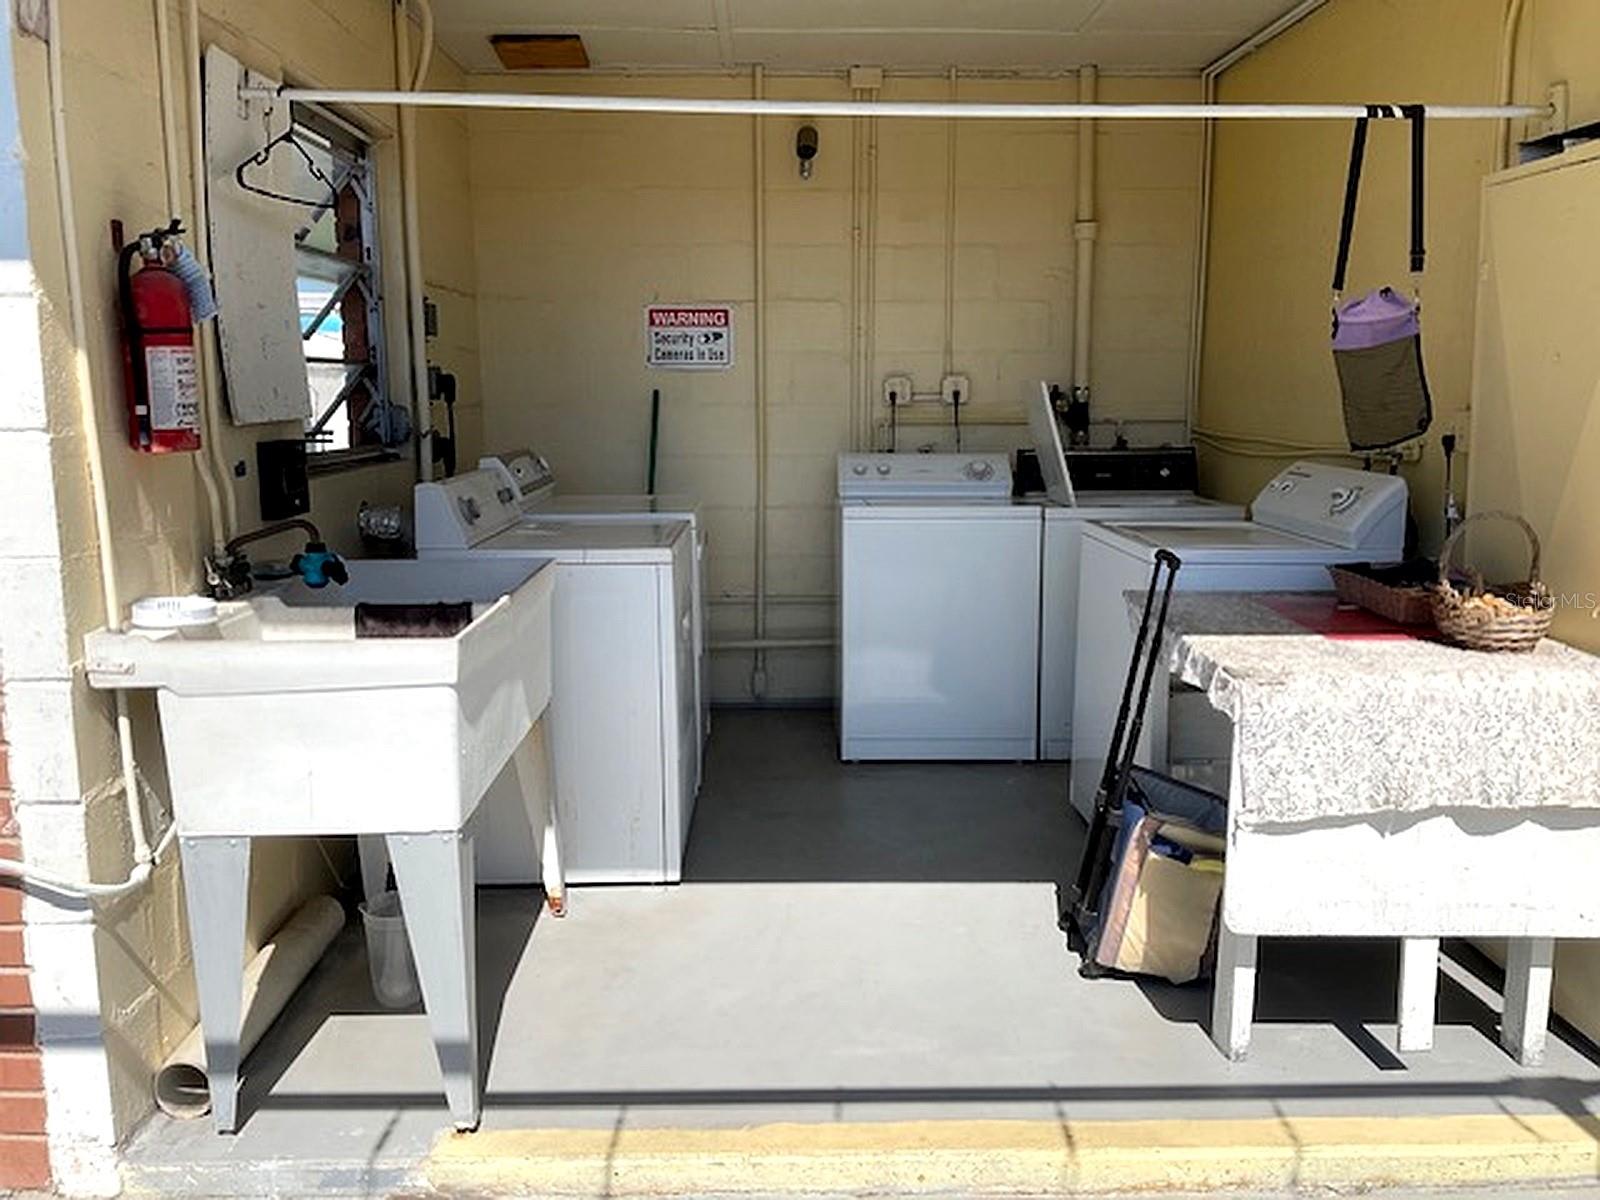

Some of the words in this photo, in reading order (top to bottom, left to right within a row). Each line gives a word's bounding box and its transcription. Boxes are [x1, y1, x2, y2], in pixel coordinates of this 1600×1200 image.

[652, 311, 726, 326] WARNING
[654, 331, 694, 347] Security
[654, 347, 694, 361] Cameras
[708, 347, 725, 361] Use
